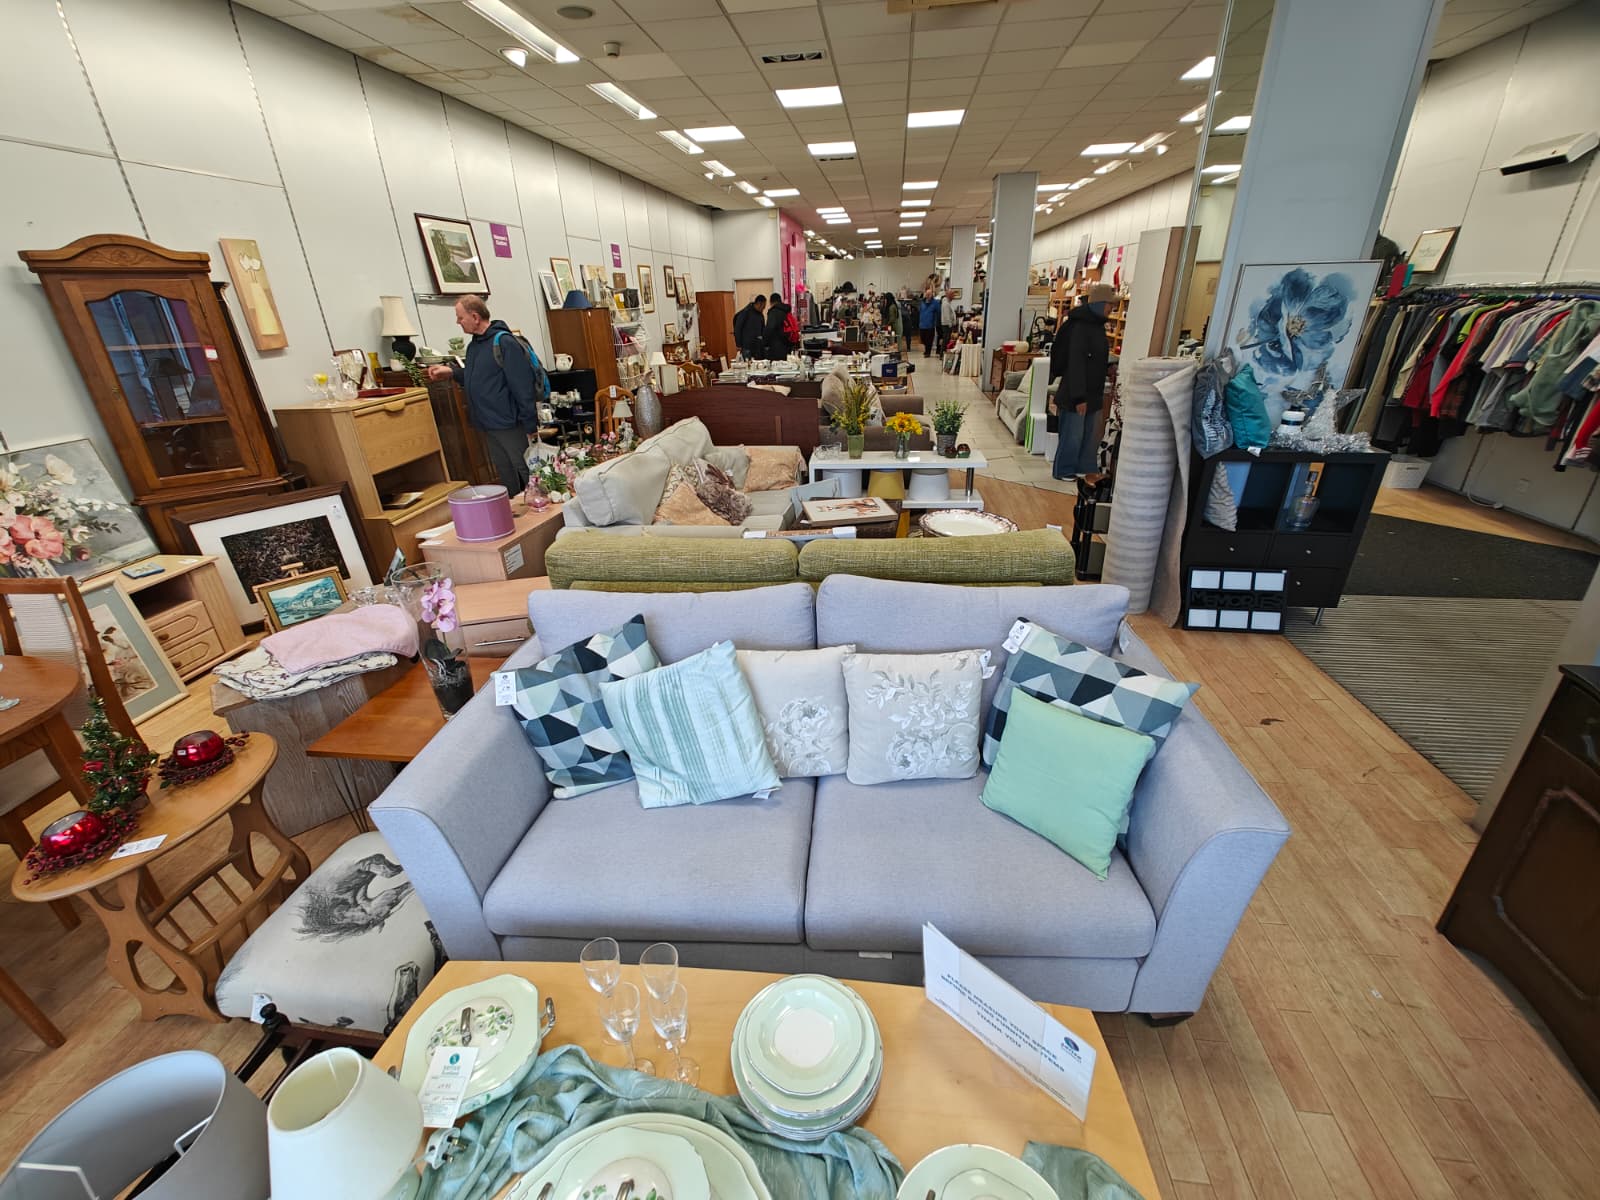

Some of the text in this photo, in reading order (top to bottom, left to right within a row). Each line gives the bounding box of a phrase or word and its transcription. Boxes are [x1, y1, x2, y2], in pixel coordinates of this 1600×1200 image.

[1192, 592, 1283, 608] MEMORIES
[941, 975, 965, 996] BEFORE
[996, 1017, 1037, 1051] FURNITURE
[1041, 1051, 1064, 1072] ITEMS
[947, 973, 971, 995] PLEASE
[974, 994, 1007, 1022] MEASURE
[1010, 1022, 1029, 1039] YOUR
[1032, 1038, 1056, 1059] SPACE
[977, 1011, 1001, 1032] THANK
[1005, 1033, 1020, 1048] YOU
